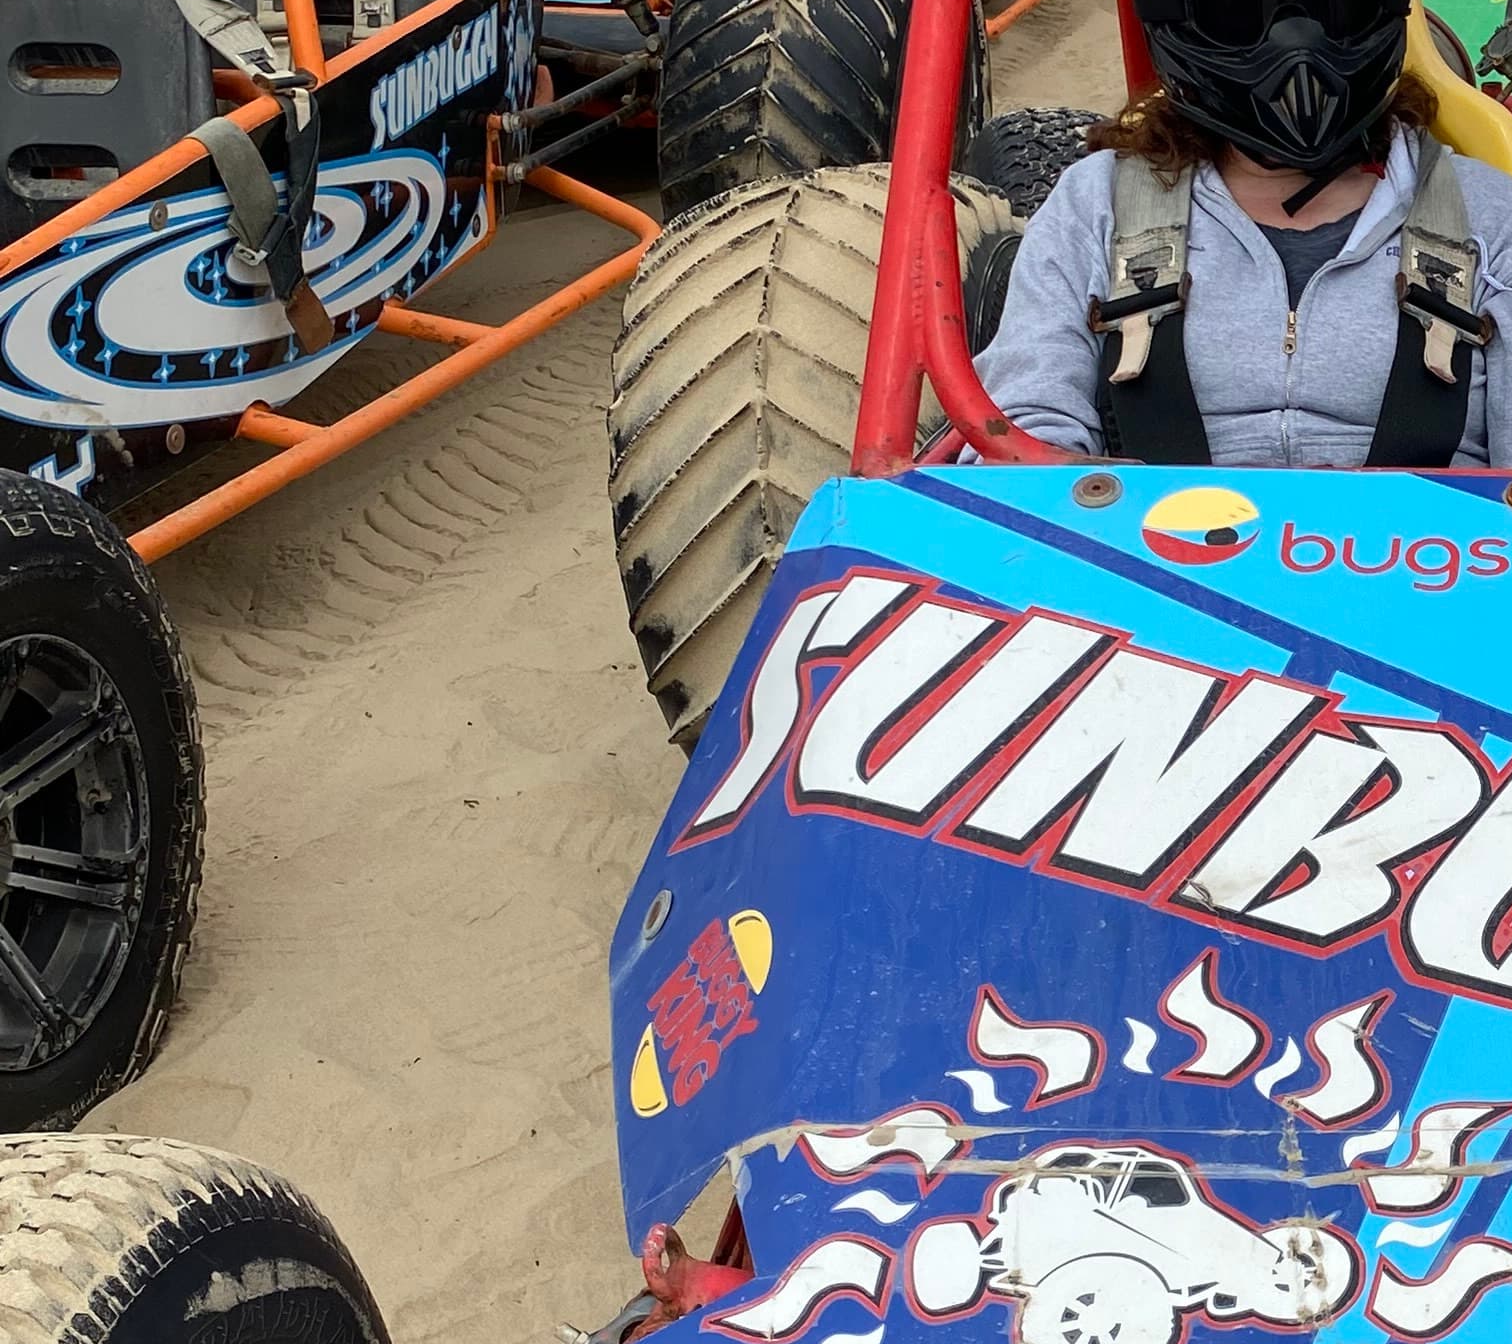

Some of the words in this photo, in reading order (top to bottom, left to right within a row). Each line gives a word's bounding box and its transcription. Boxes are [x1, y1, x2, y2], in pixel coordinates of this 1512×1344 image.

[370, 2, 498, 153] SUNBUGGY
[646, 958, 722, 1107] KING
[688, 917, 760, 1050] BUGGY
